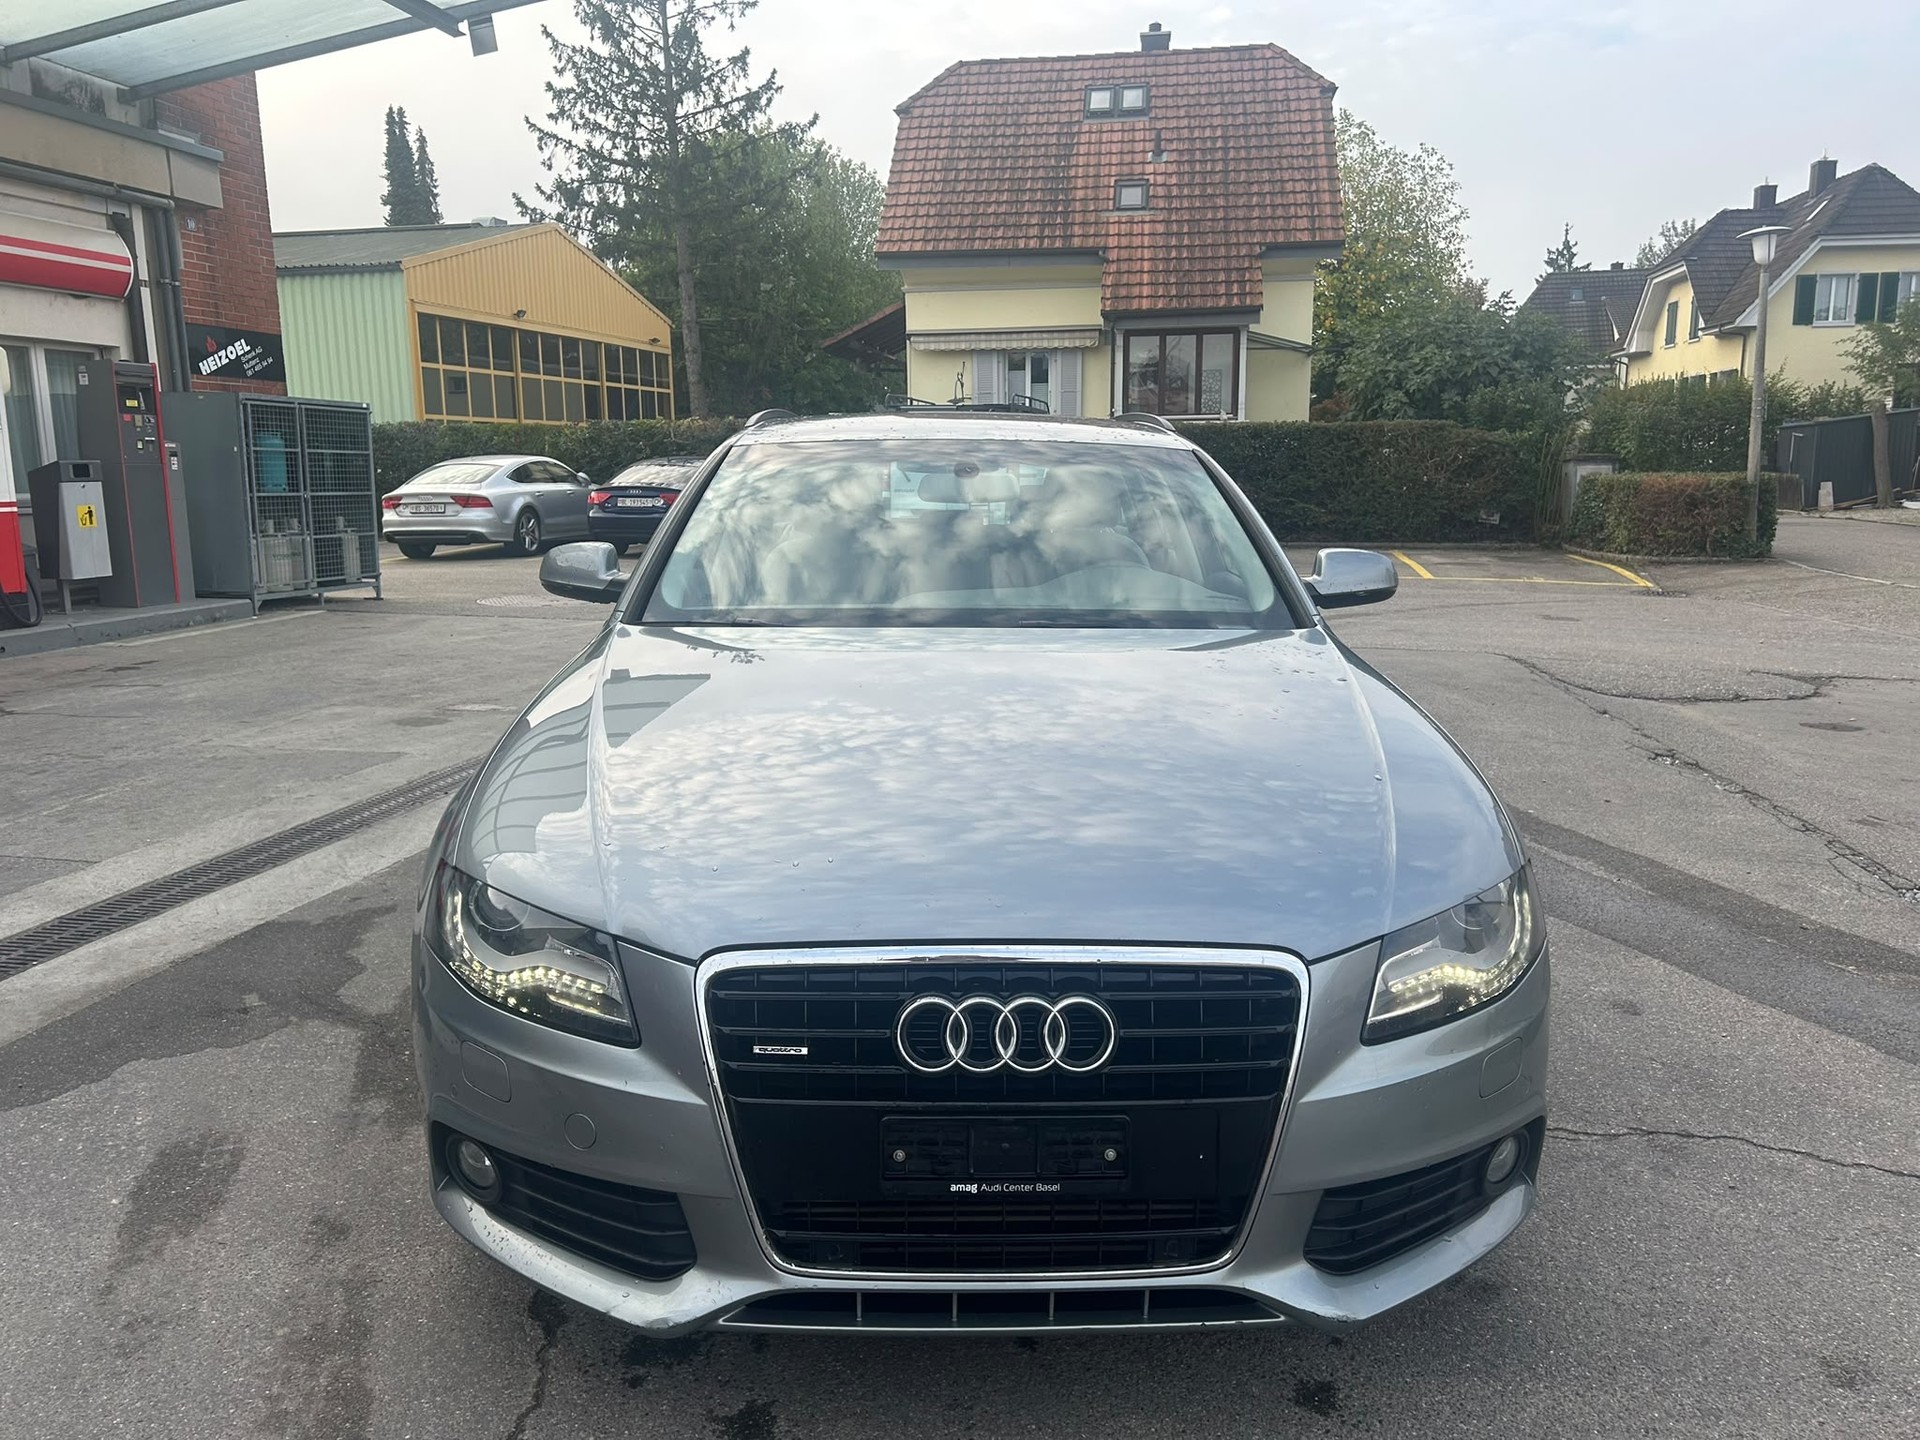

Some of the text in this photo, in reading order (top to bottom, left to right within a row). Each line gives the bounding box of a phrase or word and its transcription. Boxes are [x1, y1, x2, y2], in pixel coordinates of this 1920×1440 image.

[255, 346, 263, 354] AG
[199, 338, 251, 376] HEIZOEL
[950, 1183, 1060, 1194] amag Audi Center Basel
